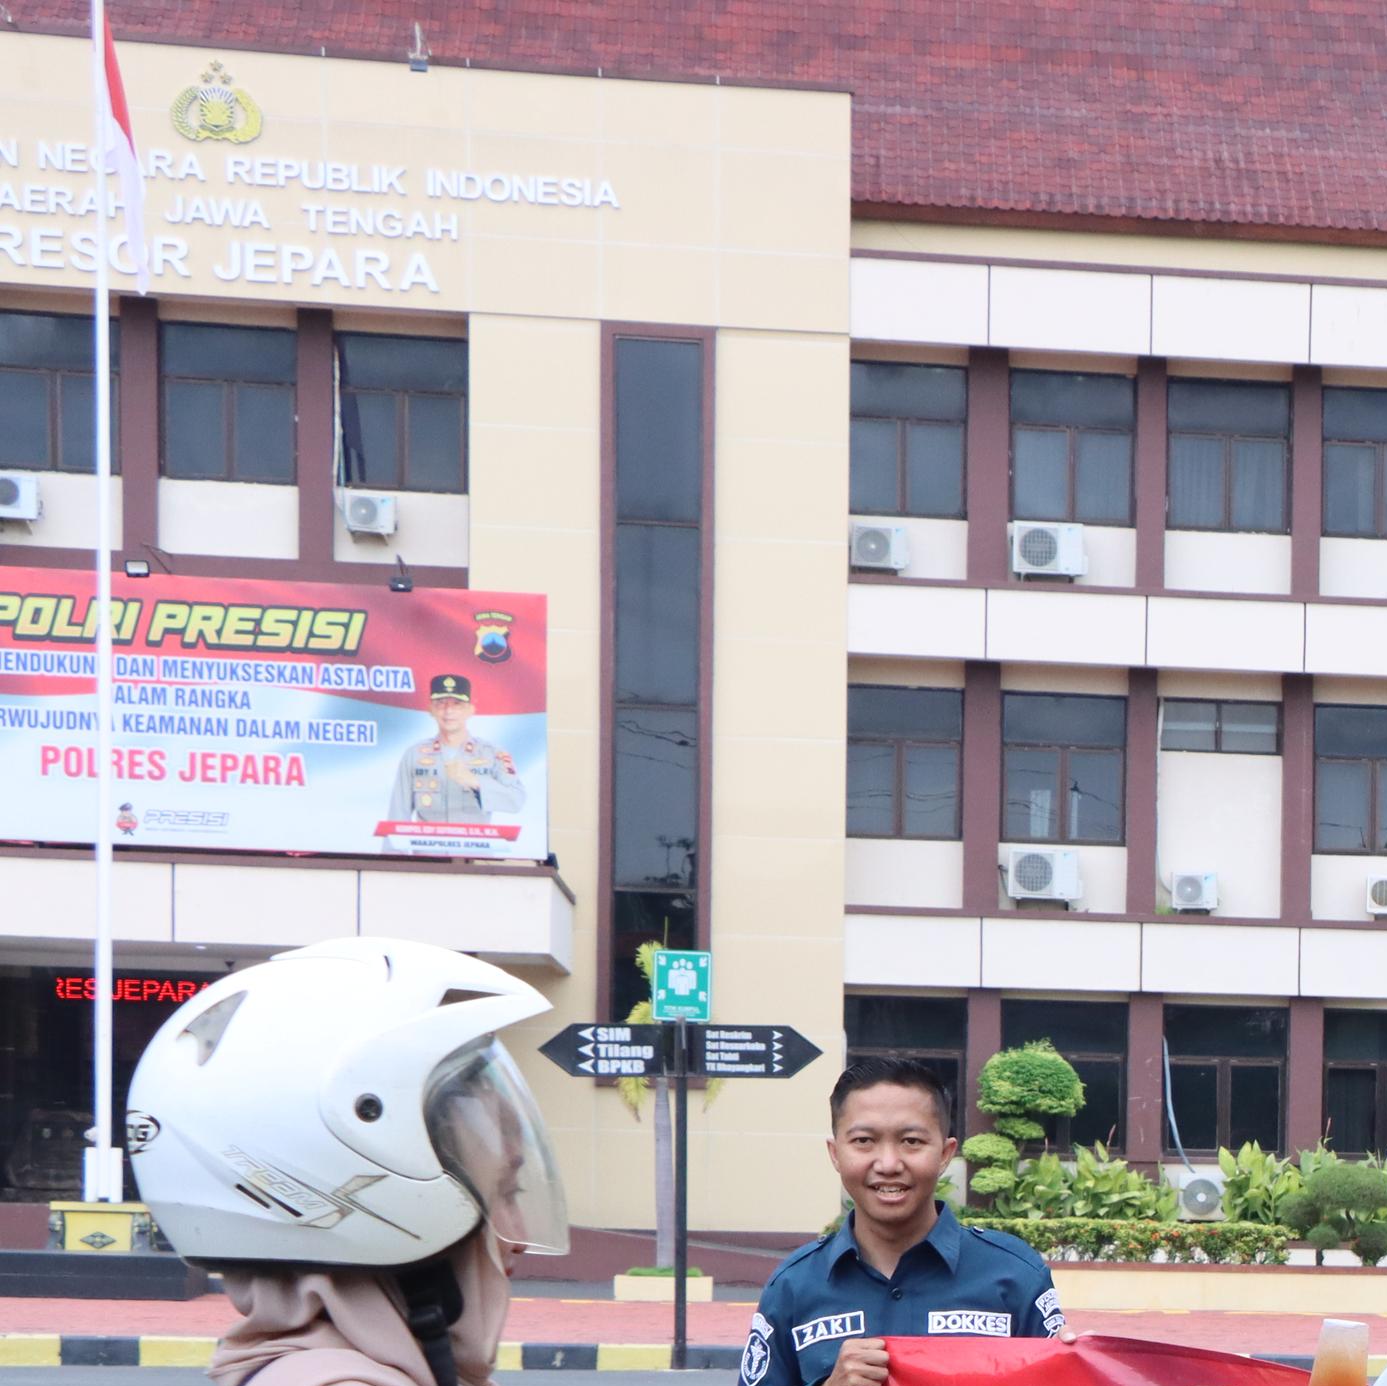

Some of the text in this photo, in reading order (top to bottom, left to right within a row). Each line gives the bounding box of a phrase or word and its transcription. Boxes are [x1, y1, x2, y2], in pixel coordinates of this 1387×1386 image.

[225, 155, 407, 195] REPUBLIK
[427, 167, 620, 208] INDONESIA
[164, 194, 271, 230] JAWA
[302, 203, 459, 241] TENGAH
[213, 239, 440, 293] JEPARA
[147, 601, 368, 654] PRESISI
[117, 657, 154, 678] DAN
[163, 658, 313, 685] MENYUKSESKAN
[320, 667, 366, 688] ASTA
[372, 668, 412, 690] CITA
[114, 685, 251, 710] ALAM RANGKA
[123, 713, 229, 737] KEAMANAN
[236, 718, 300, 739] DALAM
[308, 722, 375, 743] NEGERI
[178, 751, 306, 787] JEPARA
[596, 1027, 631, 1042] SIM
[597, 1043, 654, 1060] Tilang
[597, 1060, 646, 1074] BPKB
[802, 1313, 1007, 1342] ZAKI DOKKES
